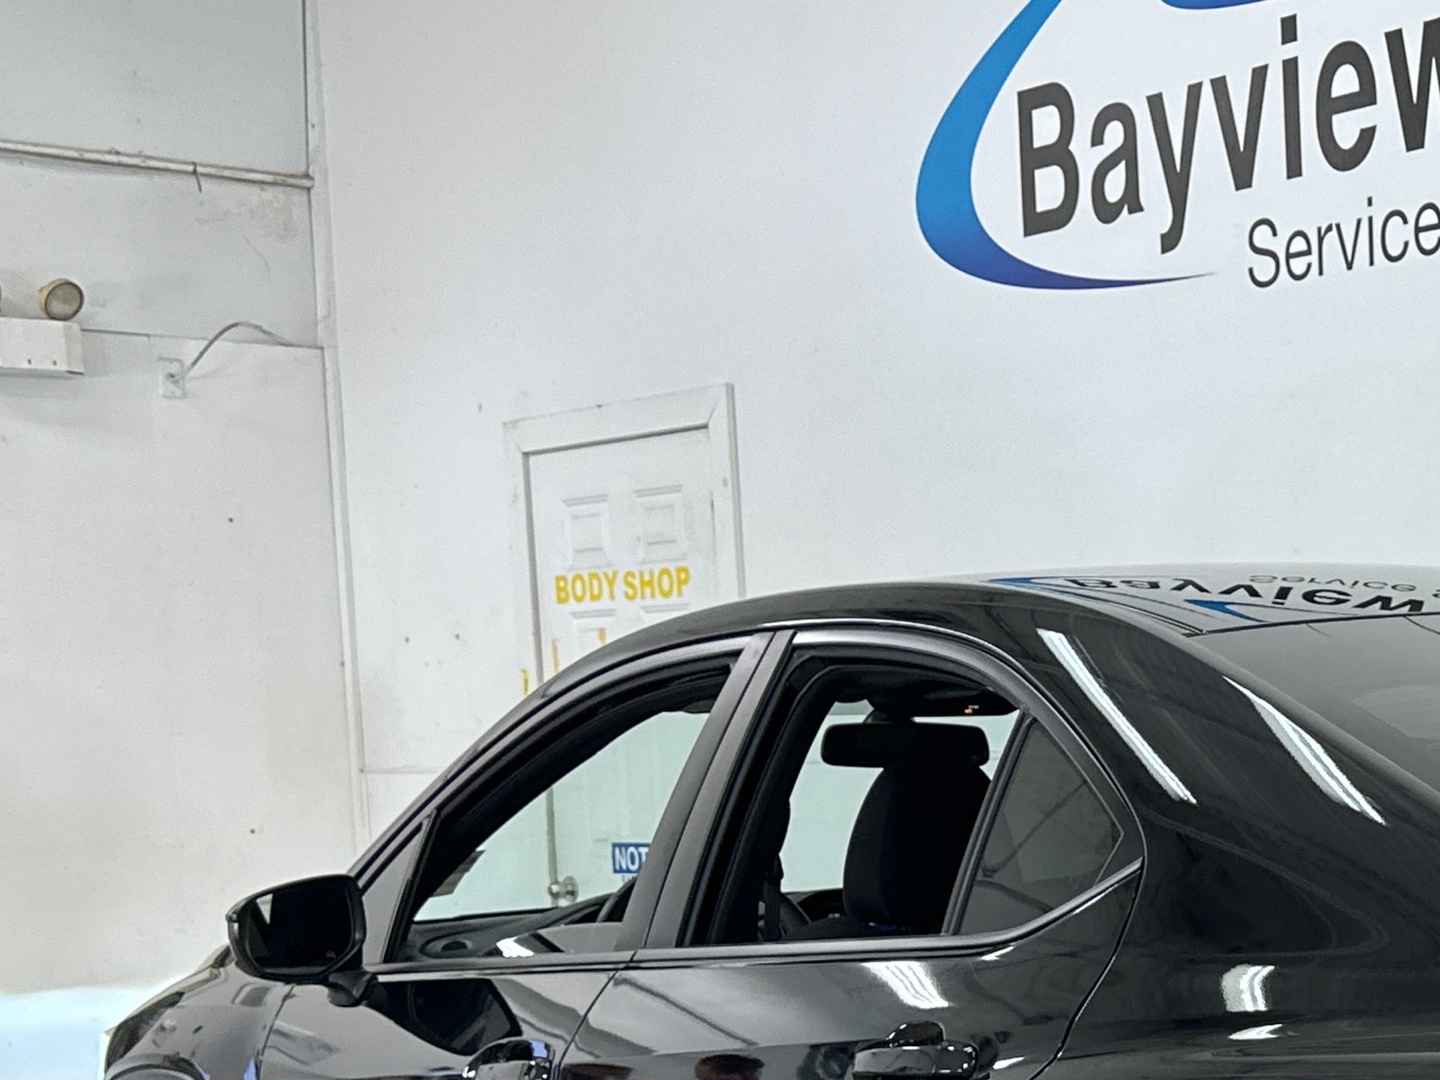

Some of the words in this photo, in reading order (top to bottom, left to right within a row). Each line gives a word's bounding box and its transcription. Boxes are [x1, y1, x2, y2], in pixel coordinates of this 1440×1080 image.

[554, 570, 618, 604] BODY
[622, 565, 691, 601] SHOP
[613, 845, 650, 871] NOT
